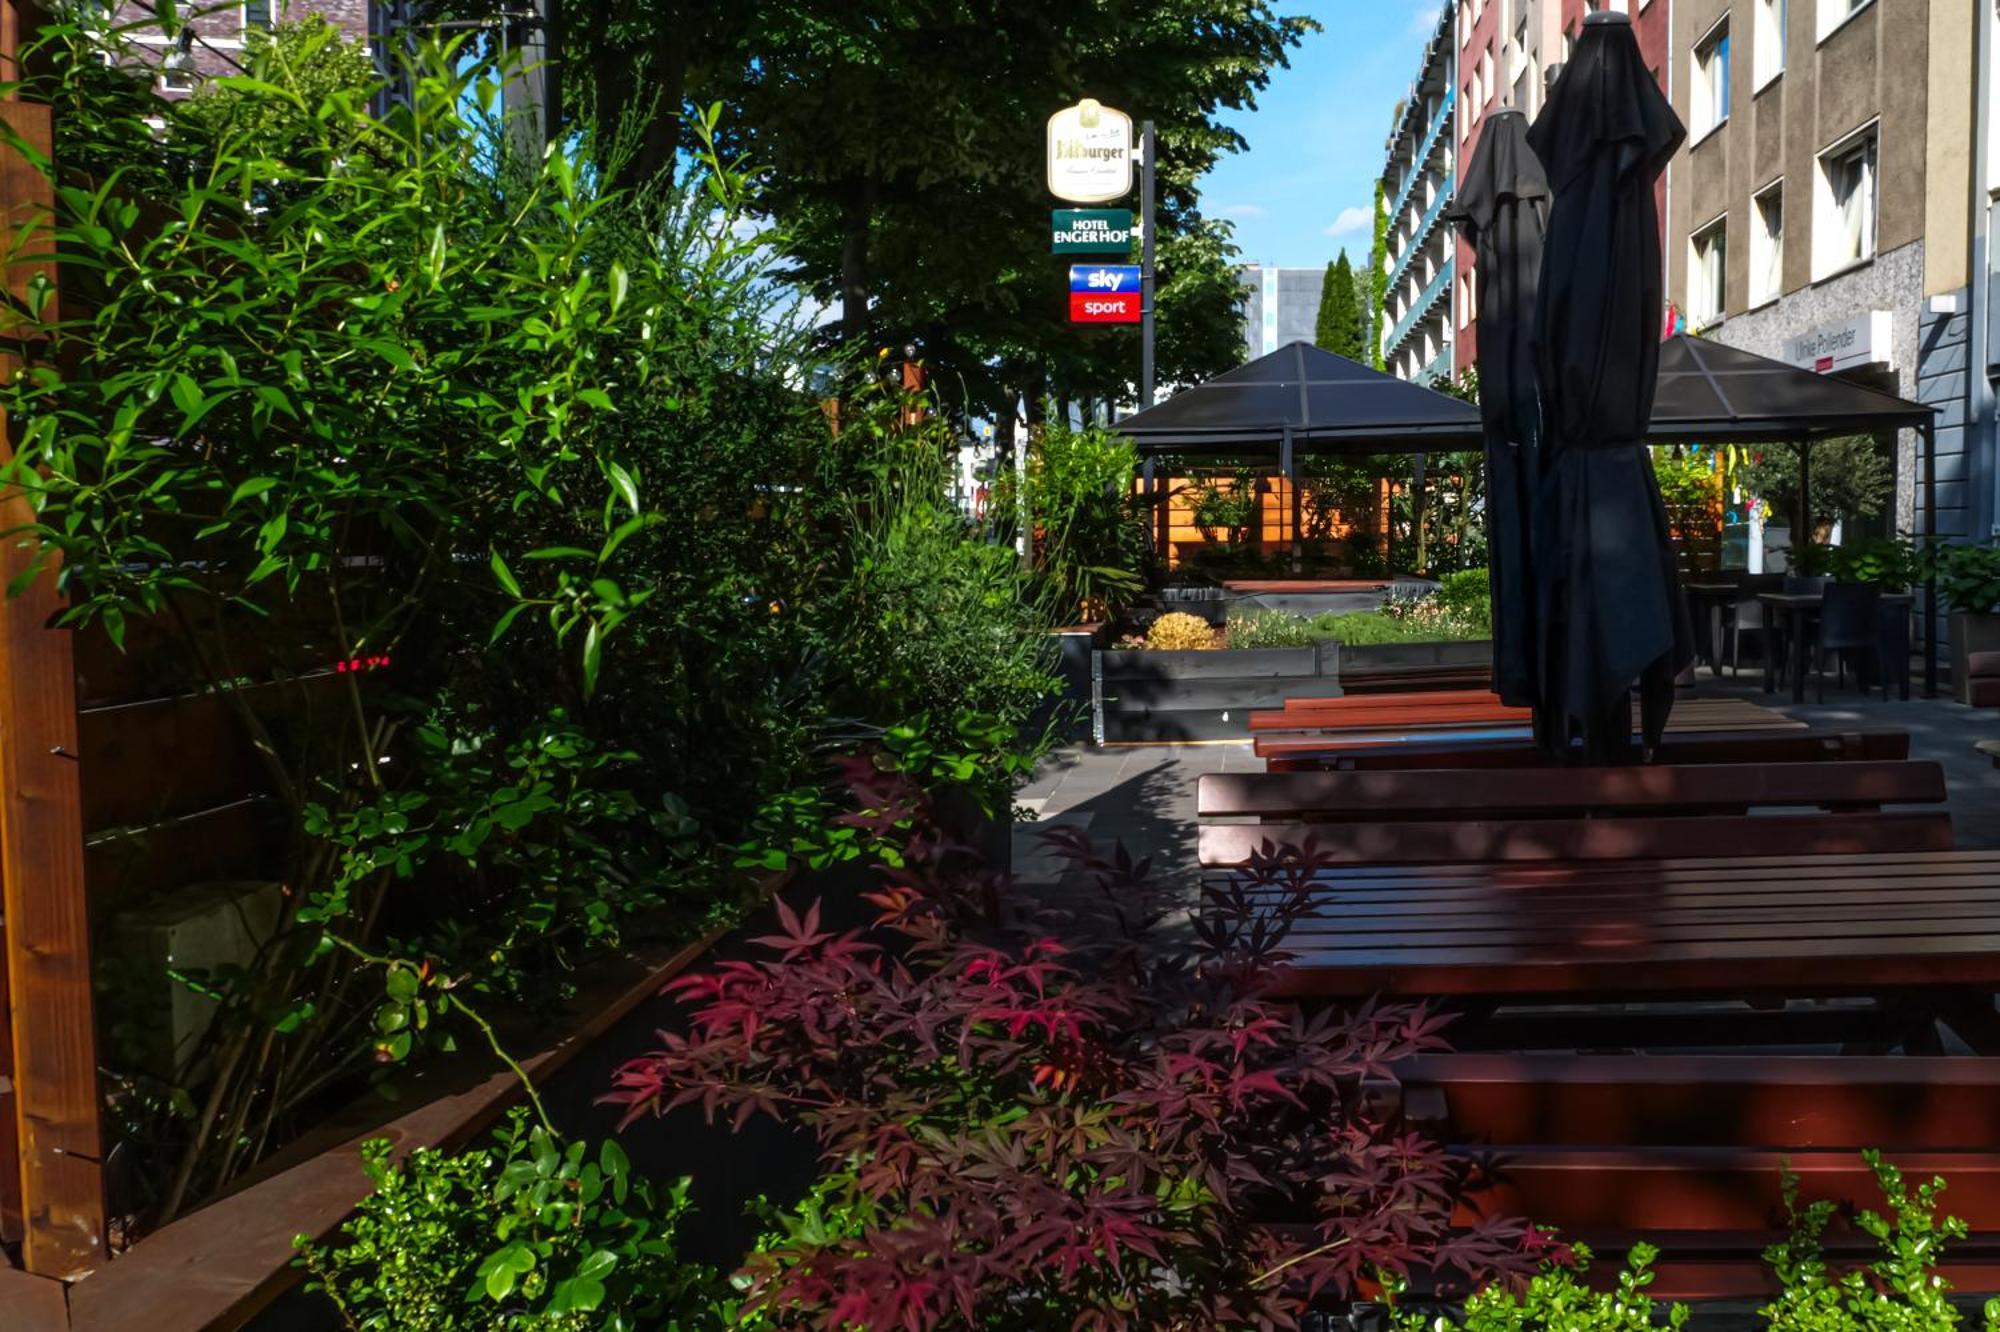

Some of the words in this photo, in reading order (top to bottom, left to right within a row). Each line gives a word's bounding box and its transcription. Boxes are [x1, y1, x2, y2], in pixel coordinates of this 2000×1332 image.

[1073, 220, 1109, 230] HOTEL
[1088, 269, 1123, 291] sky
[1085, 301, 1126, 316] sport
